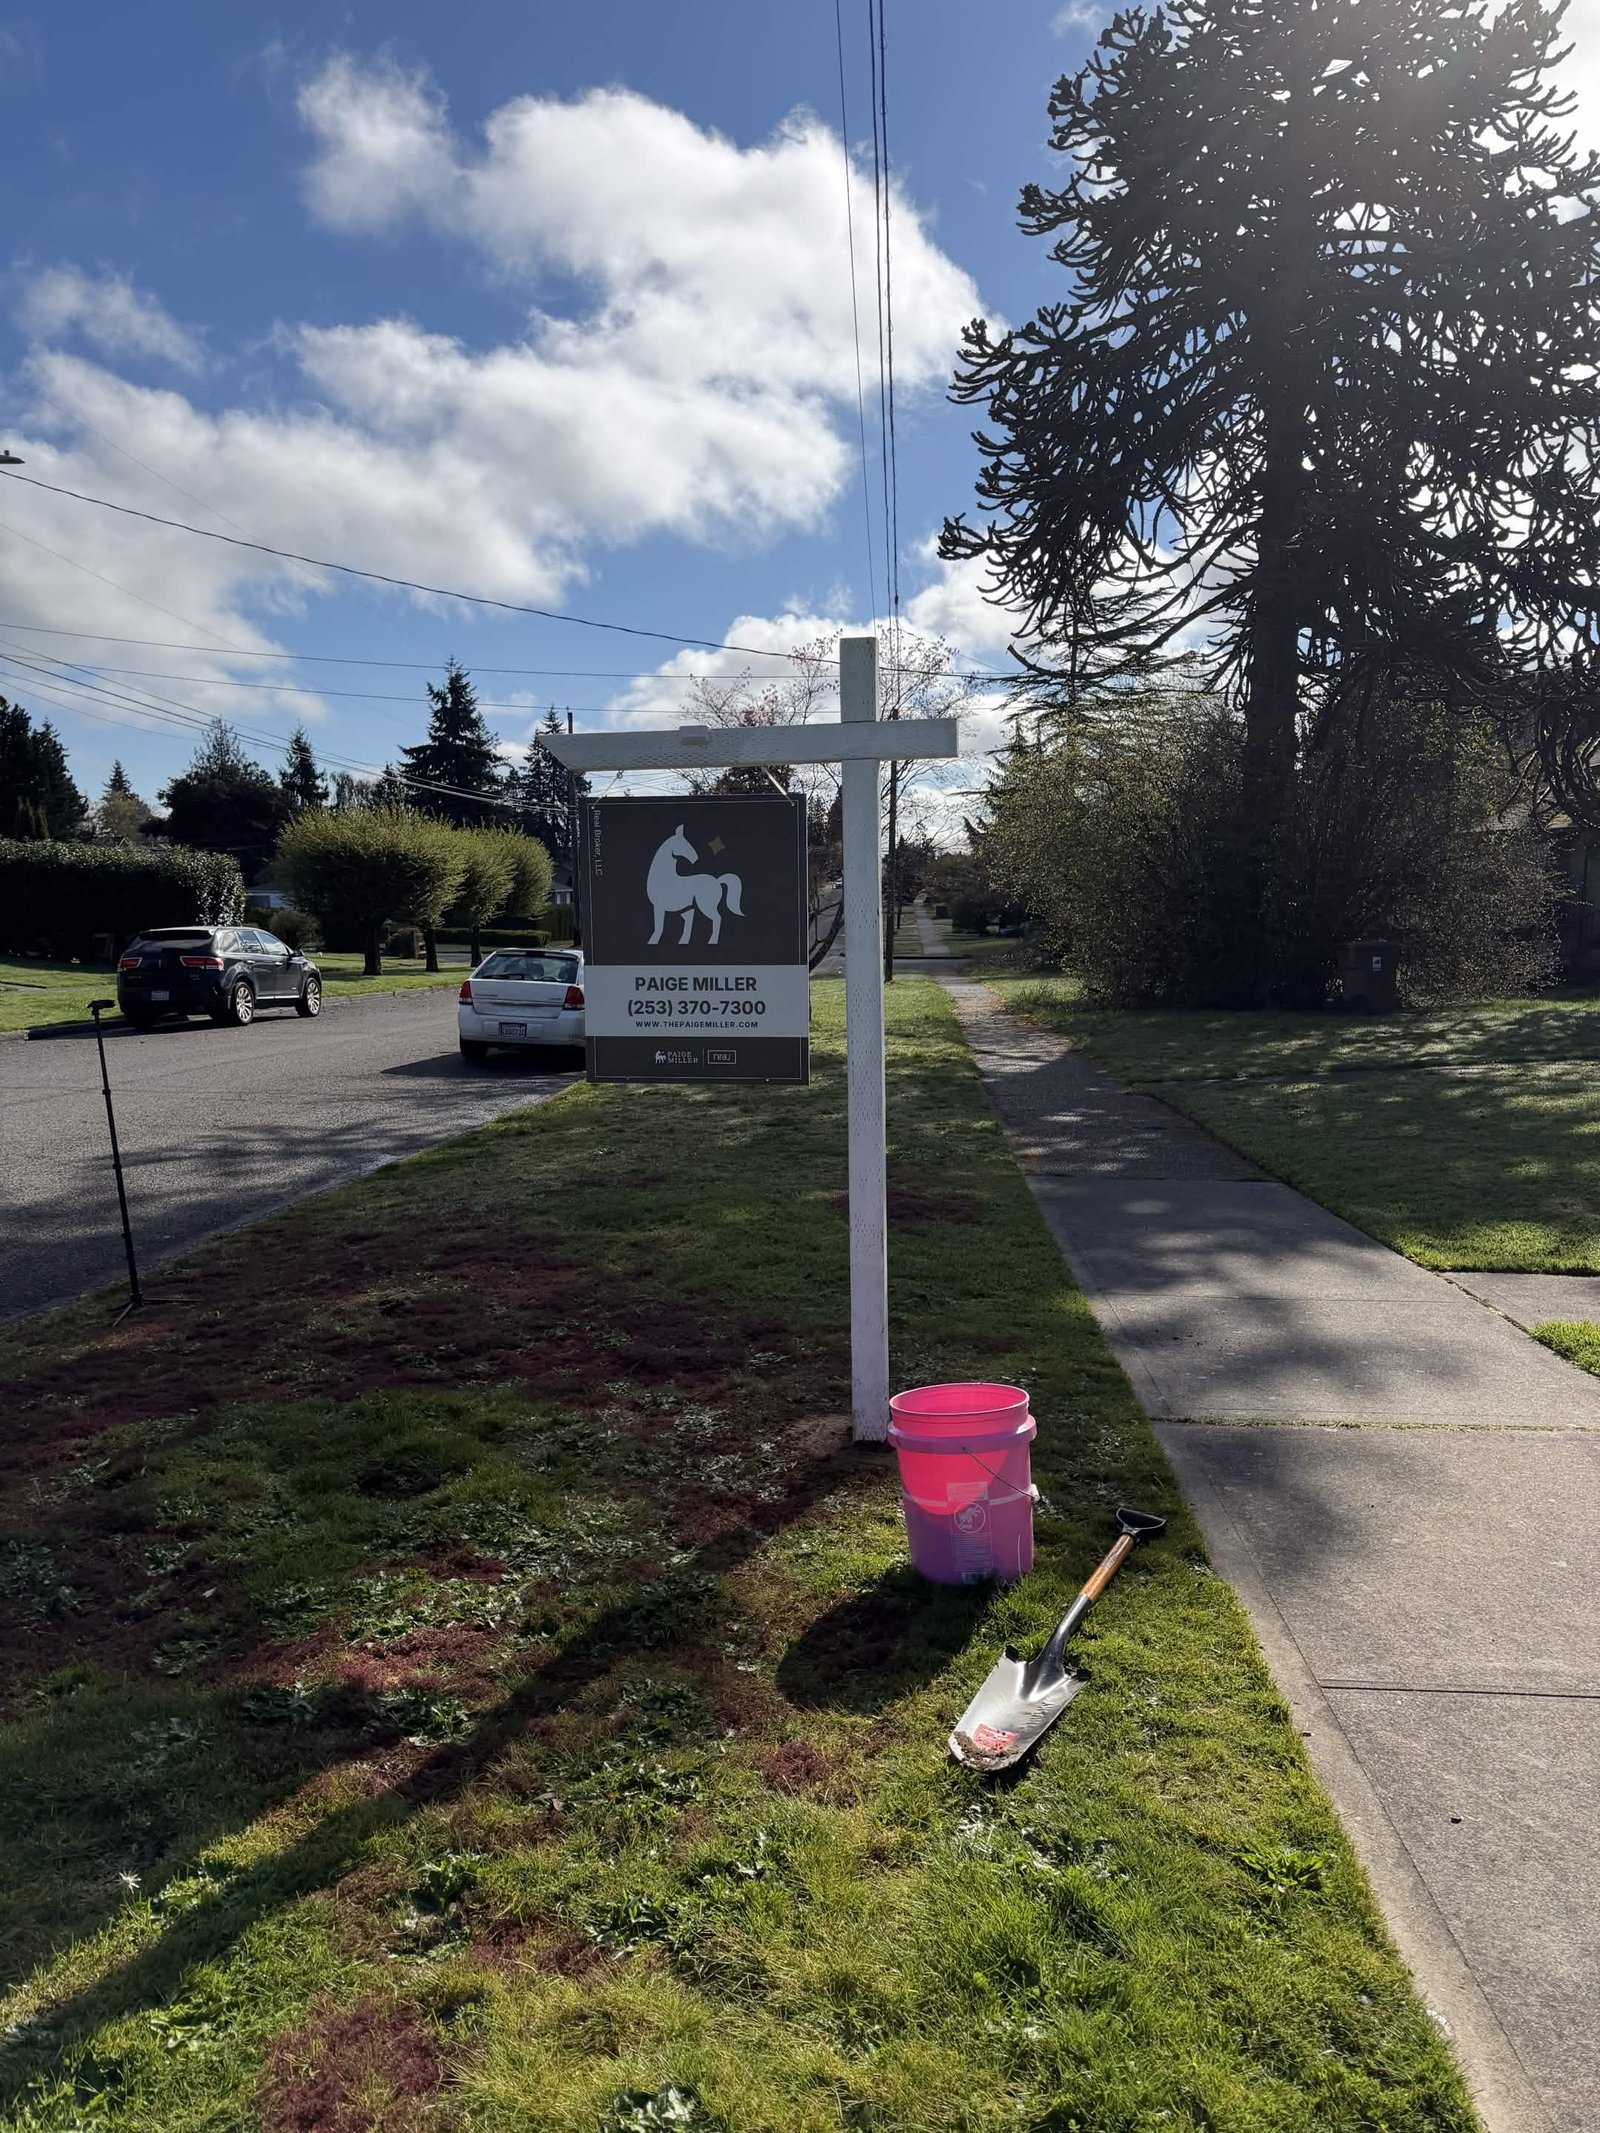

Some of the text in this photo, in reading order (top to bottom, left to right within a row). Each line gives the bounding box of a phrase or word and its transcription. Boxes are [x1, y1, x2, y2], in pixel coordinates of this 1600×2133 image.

[593, 829, 602, 858] Broker,
[595, 859, 603, 876] LLC
[635, 977, 757, 991] PAIGE MILLER
[628, 1000, 766, 1017] (253) 370-7300
